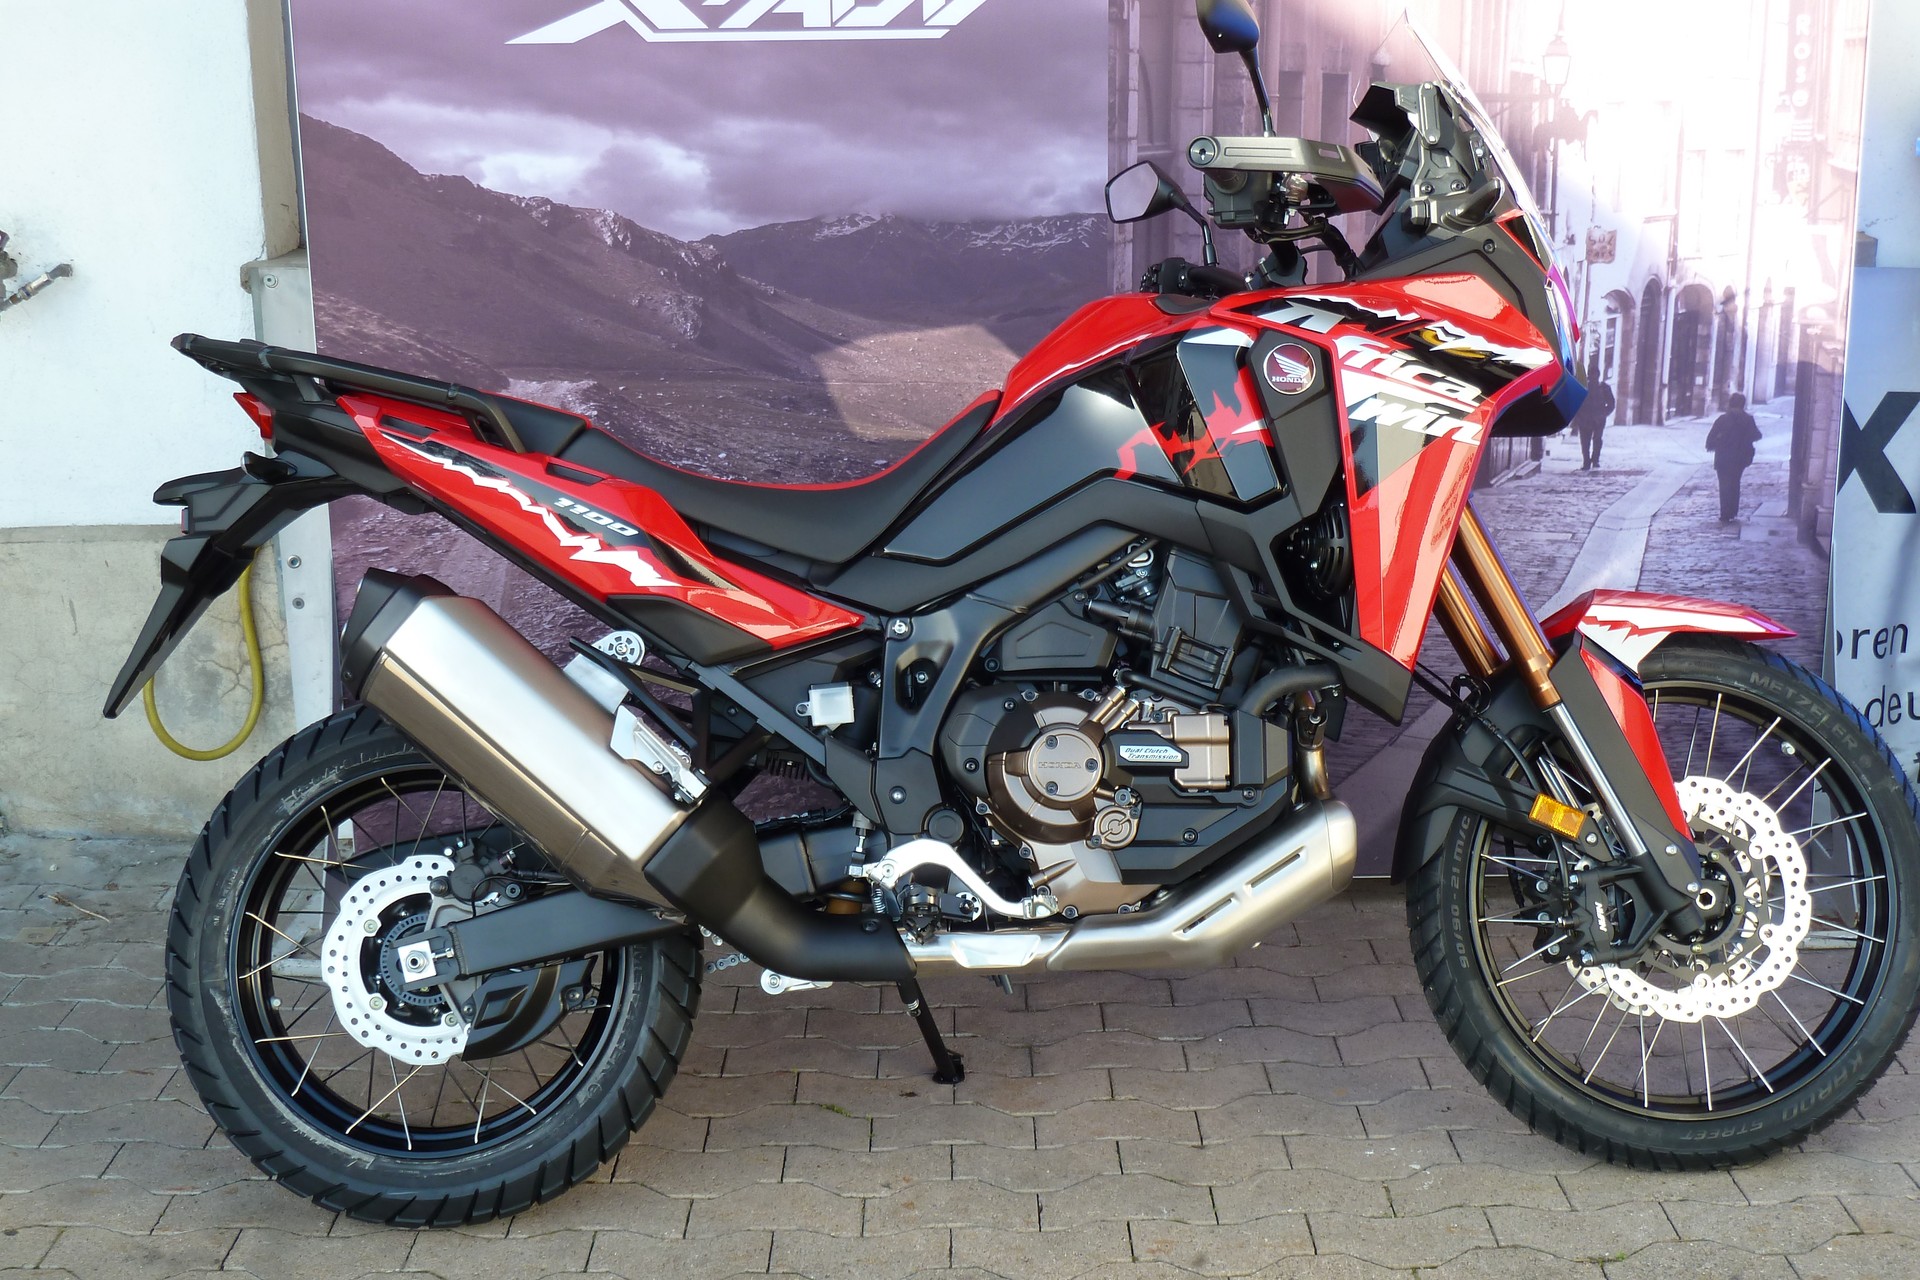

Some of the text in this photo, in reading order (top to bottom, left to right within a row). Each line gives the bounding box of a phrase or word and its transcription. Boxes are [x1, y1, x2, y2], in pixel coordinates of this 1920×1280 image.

[1271, 375, 1308, 384] HONDA
[553, 497, 639, 537] 1100
[1836, 622, 1909, 660] ren
[1749, 671, 1860, 750] METZELER
[1038, 761, 1082, 769] HONDA
[1127, 752, 1179, 760] Transmission
[1451, 906, 1469, 969] 90/90
[1680, 1051, 1863, 1142] KAROO STREET
